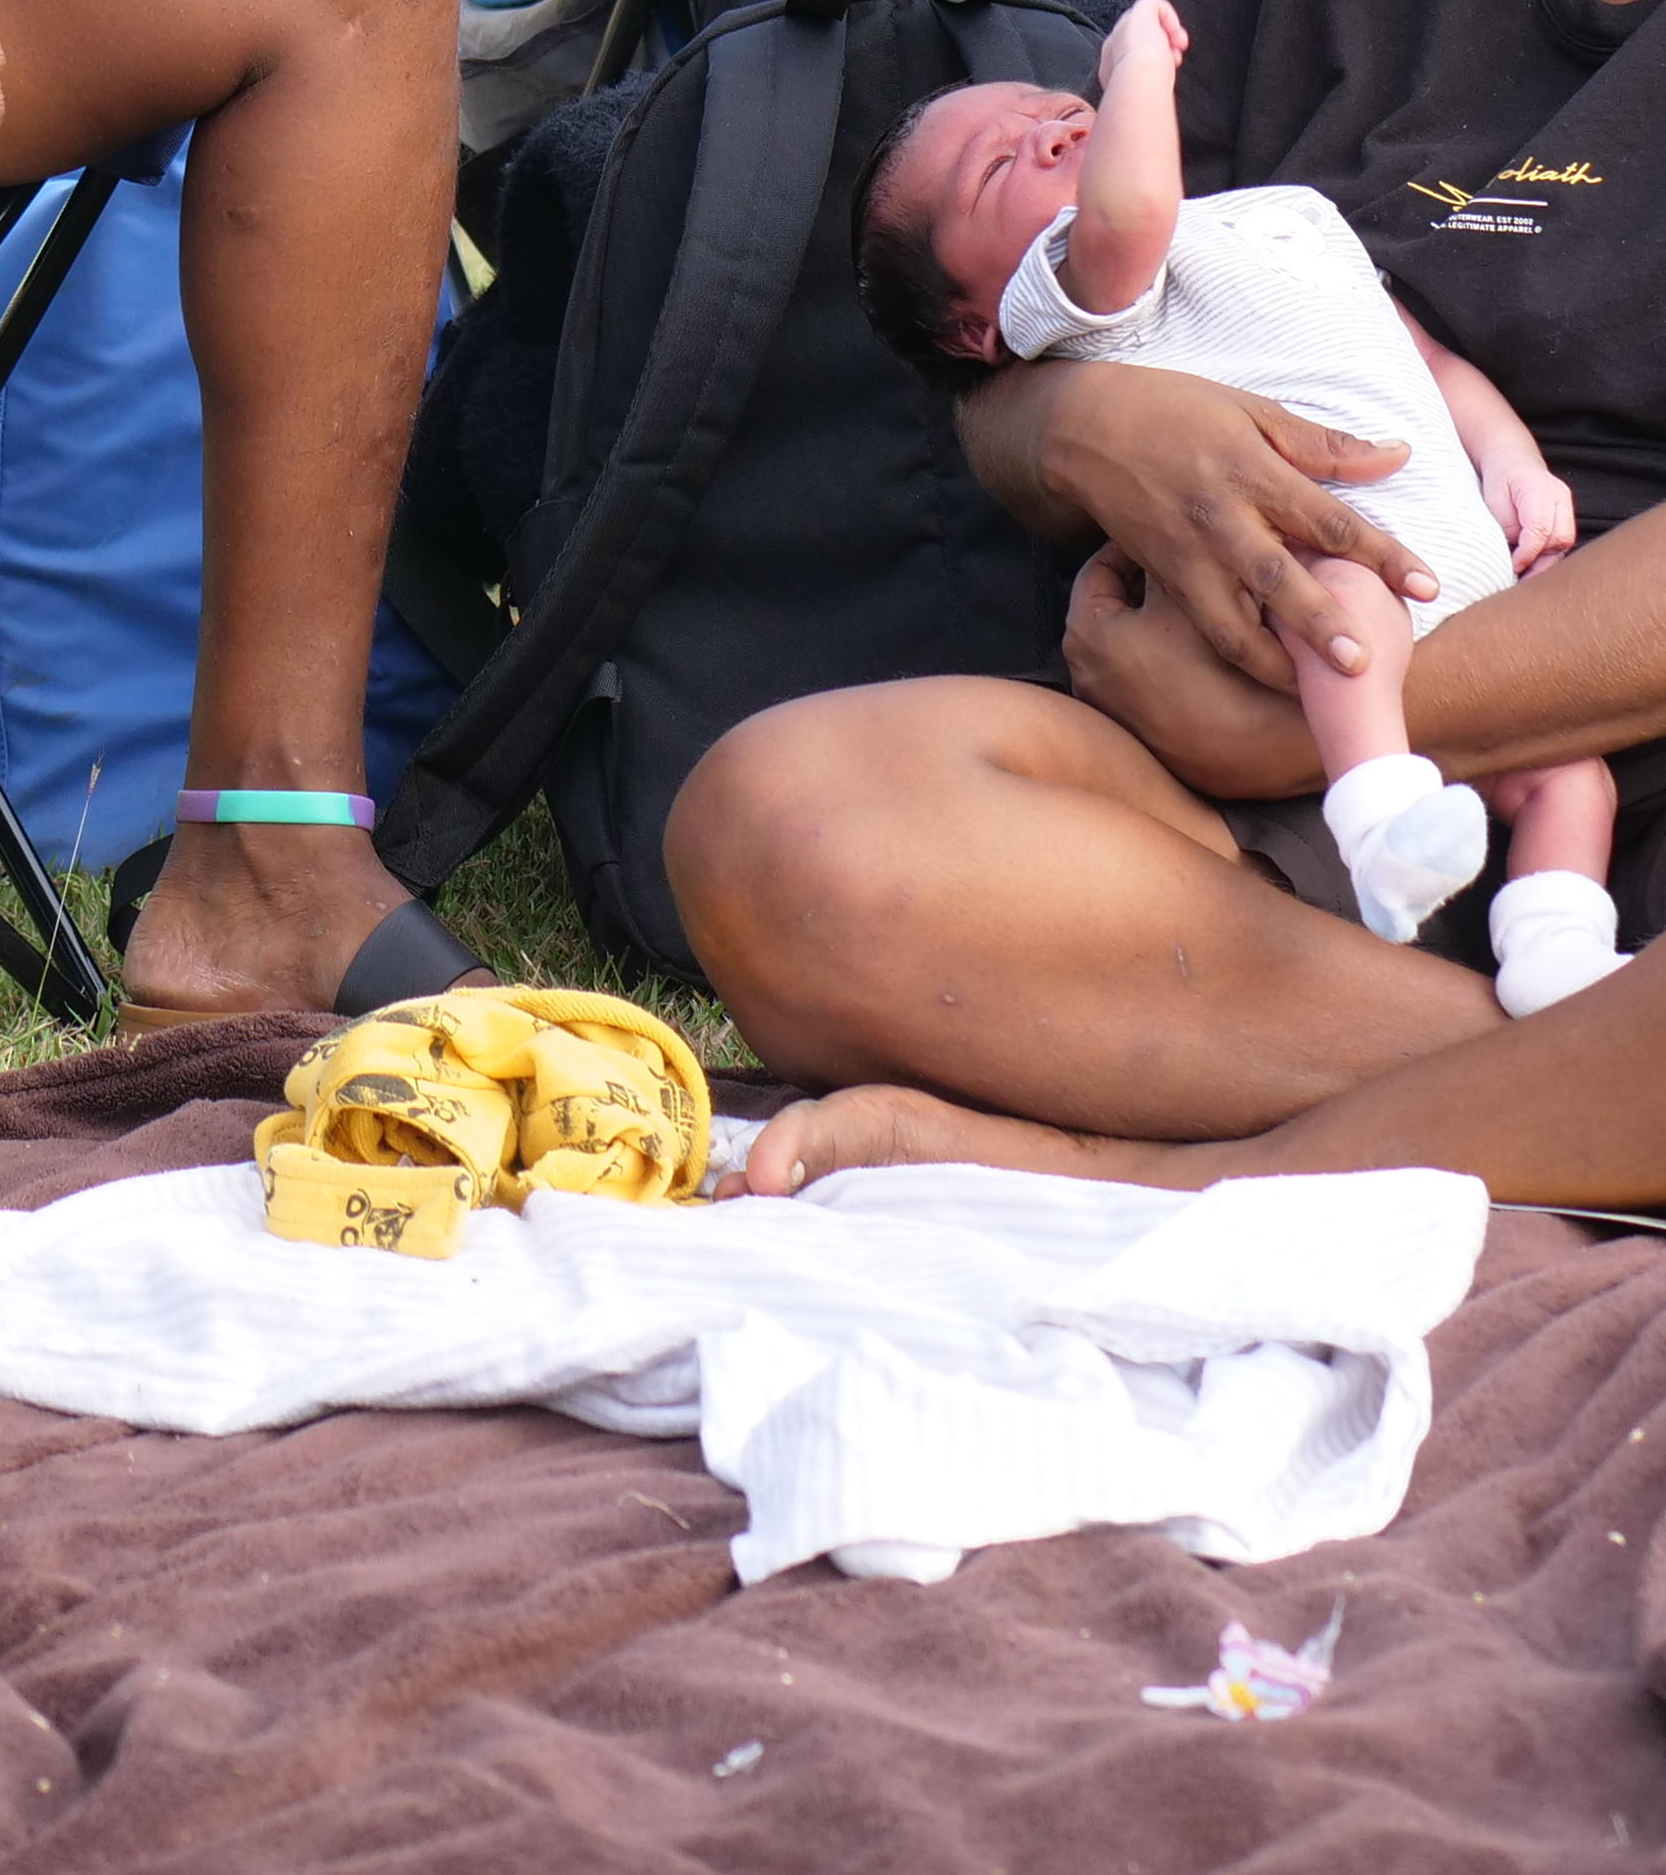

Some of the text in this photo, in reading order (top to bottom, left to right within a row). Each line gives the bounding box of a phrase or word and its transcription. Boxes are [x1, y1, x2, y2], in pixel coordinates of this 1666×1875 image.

[1487, 156, 1602, 185] oliath
[1496, 215, 1512, 224] EST
[1447, 221, 1533, 234] LEGITIMATE APPAREL
